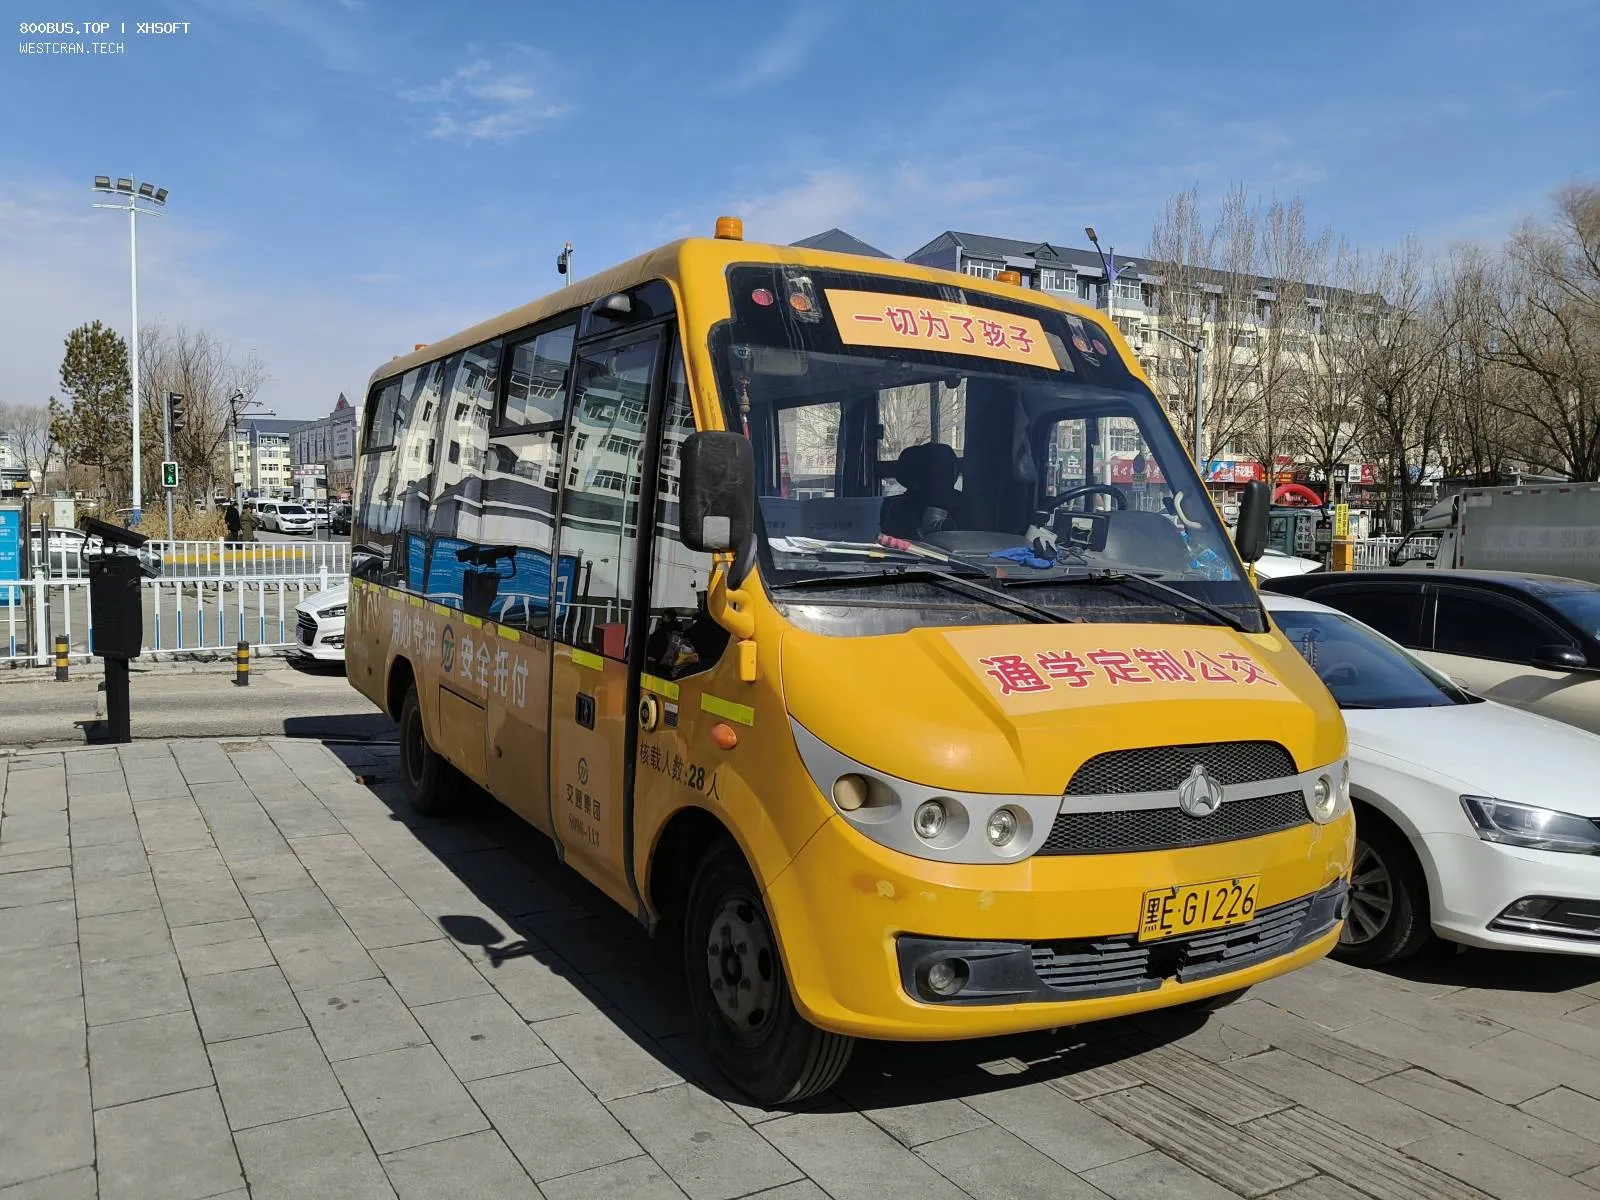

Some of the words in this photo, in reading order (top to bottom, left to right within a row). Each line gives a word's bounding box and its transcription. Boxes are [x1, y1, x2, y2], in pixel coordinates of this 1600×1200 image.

[853, 306, 1034, 353] 一切为了孩子
[460, 634, 529, 708] 安全托付
[979, 648, 1279, 695] 通学定制公交
[565, 783, 601, 822] 交通集团
